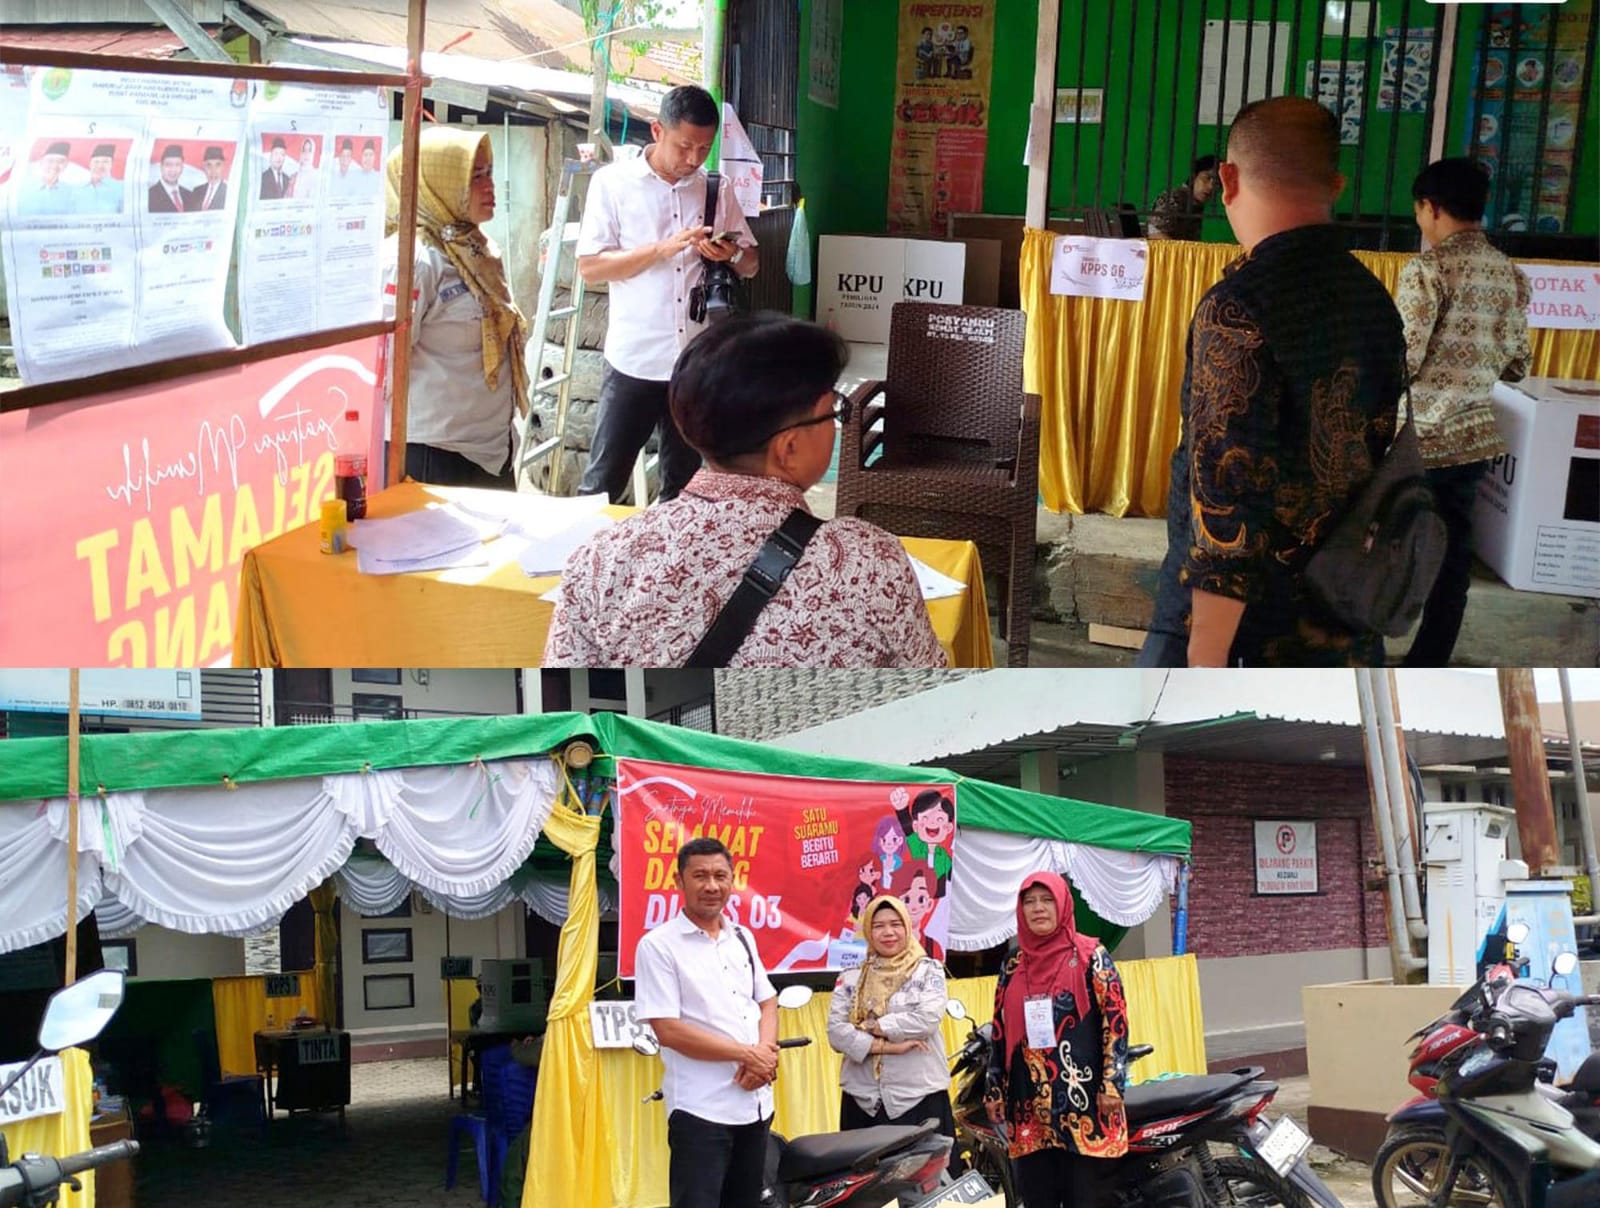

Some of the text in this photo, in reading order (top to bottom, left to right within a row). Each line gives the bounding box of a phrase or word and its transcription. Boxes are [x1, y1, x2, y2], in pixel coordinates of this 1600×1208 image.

[1080, 262, 1126, 278] KPPS 06
[838, 273, 883, 294] KPU
[903, 279, 943, 299] KPU
[1531, 277, 1587, 292] OTAK
[802, 807, 828, 824] SATU
[793, 820, 840, 841] SUARAMU
[802, 836, 835, 854] BEGITU
[800, 849, 840, 869] BERARTI
[644, 857, 751, 891] DAG
[750, 895, 783, 930] 03
[594, 1005, 643, 1041] TPS
[302, 1038, 337, 1062] TINTA
